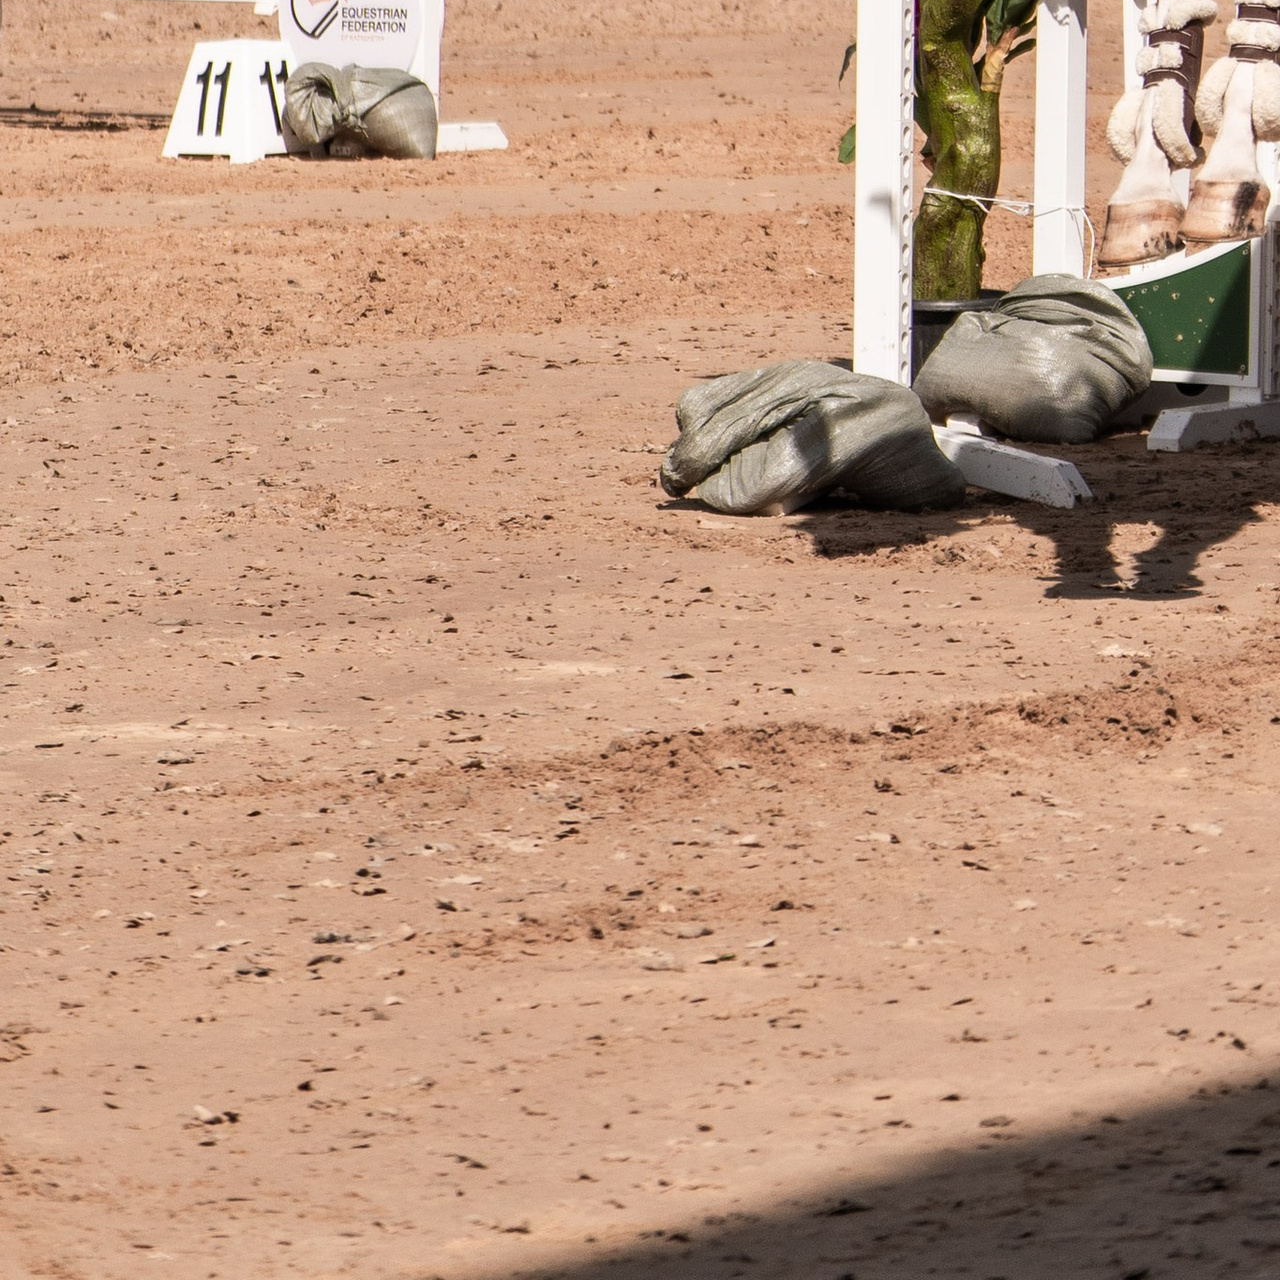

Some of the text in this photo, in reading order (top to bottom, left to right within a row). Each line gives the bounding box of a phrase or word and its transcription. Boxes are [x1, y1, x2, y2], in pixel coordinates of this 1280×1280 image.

[341, 7, 408, 19] EQUESTRIAN
[341, 21, 406, 33] FEDERATION
[196, 61, 232, 136] 11
